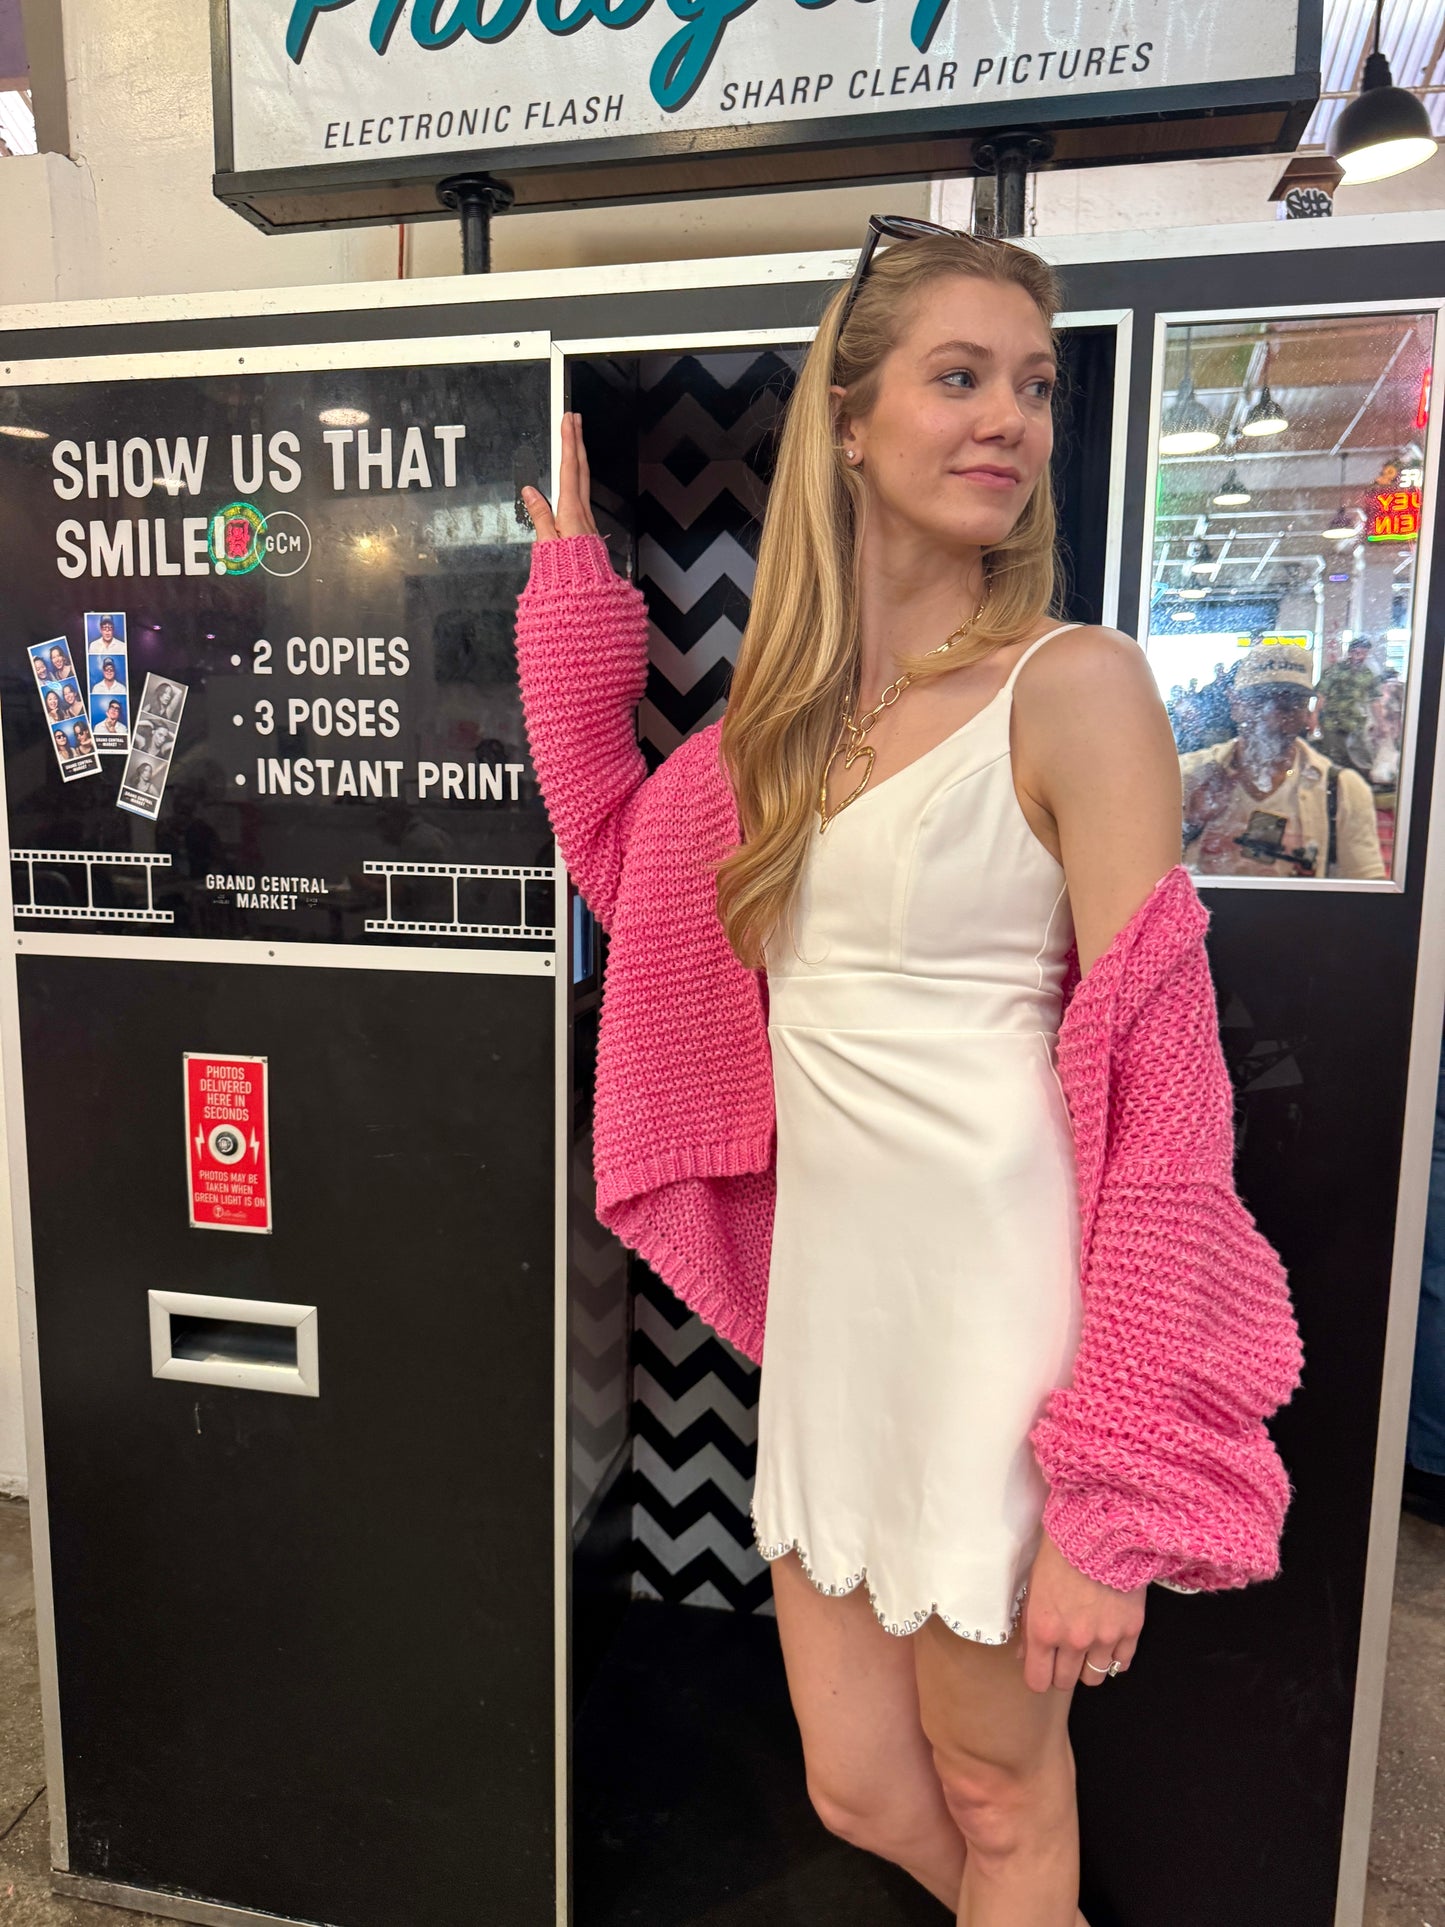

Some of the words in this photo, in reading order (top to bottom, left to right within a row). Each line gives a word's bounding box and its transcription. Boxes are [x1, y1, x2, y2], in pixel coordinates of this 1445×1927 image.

[324, 105, 511, 149] ELECTRONIC
[525, 94, 624, 130] FLASH
[720, 73, 834, 111] SHARP
[848, 61, 958, 99] CLEAR
[972, 42, 1154, 88] PICTURES
[52, 435, 209, 500] SHOW
[231, 430, 302, 495] US
[322, 425, 466, 491] THAT
[55, 516, 228, 579] SMILE!
[265, 532, 301, 555] GCM
[253, 639, 273, 675] 2
[286, 636, 410, 676] COPIES
[255, 699, 275, 735] 3
[288, 697, 400, 738] POSES
[257, 757, 404, 798] INSTANT
[417, 762, 525, 801] PRINT
[205, 873, 256, 891] GRAND
[260, 875, 329, 894] CENTRAL
[236, 892, 298, 911] MARKET
[206, 1065, 245, 1080] PHOTOS
[200, 1078, 252, 1094] DELIVERED
[207, 1092, 232, 1105] HERE
[235, 1094, 246, 1107] IN
[204, 1106, 249, 1121] SECONDS
[199, 1169, 229, 1182] PHOTOS
[230, 1172, 247, 1183] MAY
[248, 1173, 259, 1185] BE
[205, 1181, 229, 1193] TAKEN
[231, 1183, 254, 1195] WHEN
[194, 1192, 219, 1204] GREEN
[220, 1194, 242, 1206] LIGHT
[244, 1196, 253, 1207] IS
[254, 1197, 266, 1208] ON
